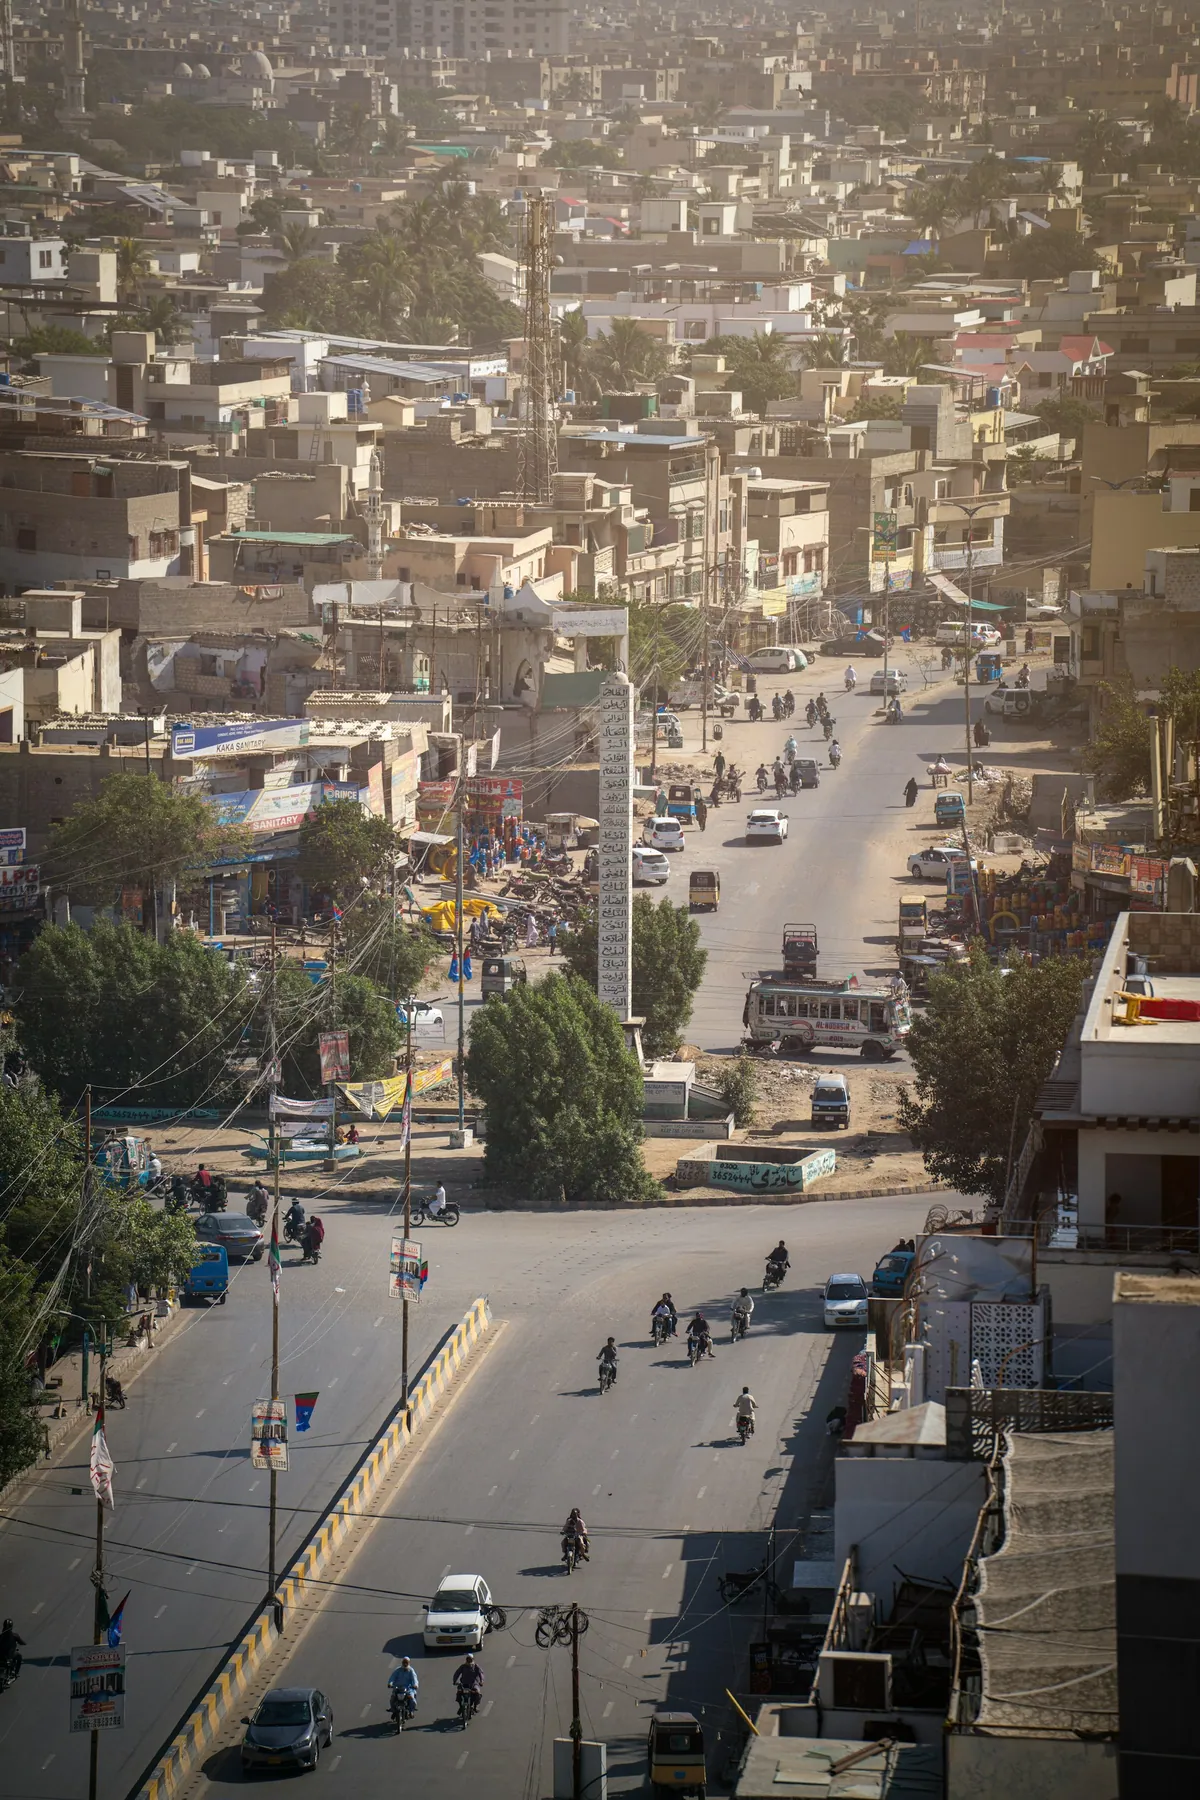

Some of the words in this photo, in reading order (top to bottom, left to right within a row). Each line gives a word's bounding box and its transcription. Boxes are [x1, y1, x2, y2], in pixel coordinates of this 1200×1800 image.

[216, 742, 235, 753] KAKA
[235, 739, 266, 752] SANITARY
[252, 815, 299, 831] SANITARY
[712, 1171, 750, 1184] 3652444
